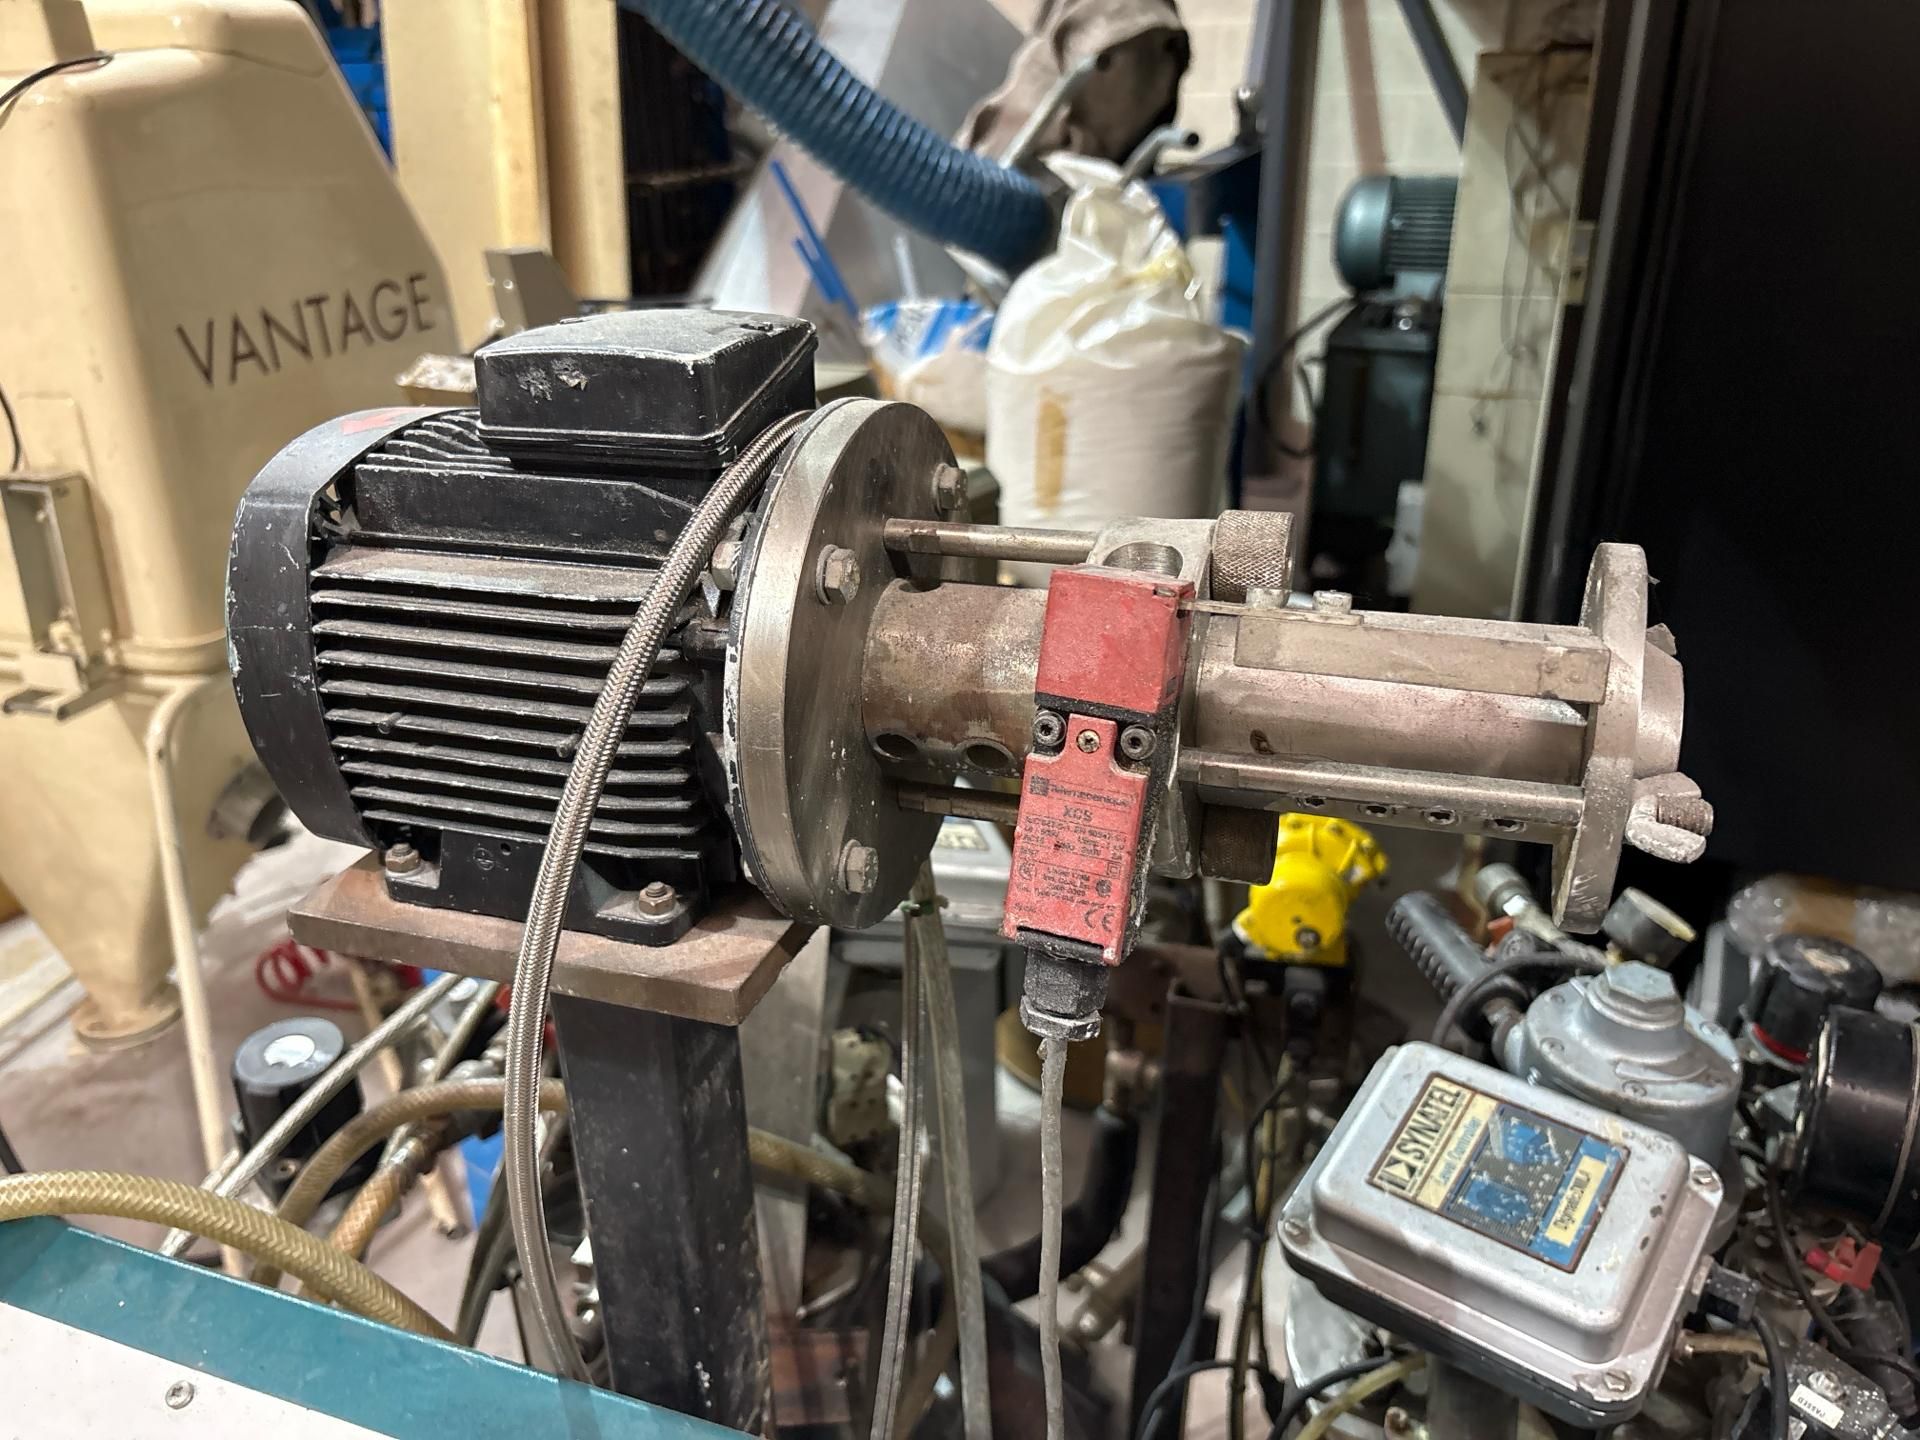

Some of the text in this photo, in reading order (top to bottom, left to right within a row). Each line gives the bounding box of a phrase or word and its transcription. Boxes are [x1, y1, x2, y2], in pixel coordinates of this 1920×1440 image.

[175, 272, 435, 388] VANTAGE
[1063, 805, 1093, 823] XCS
[1395, 1085, 1461, 1161] SYNATEL
[1798, 1397, 1827, 1418] PASSED
